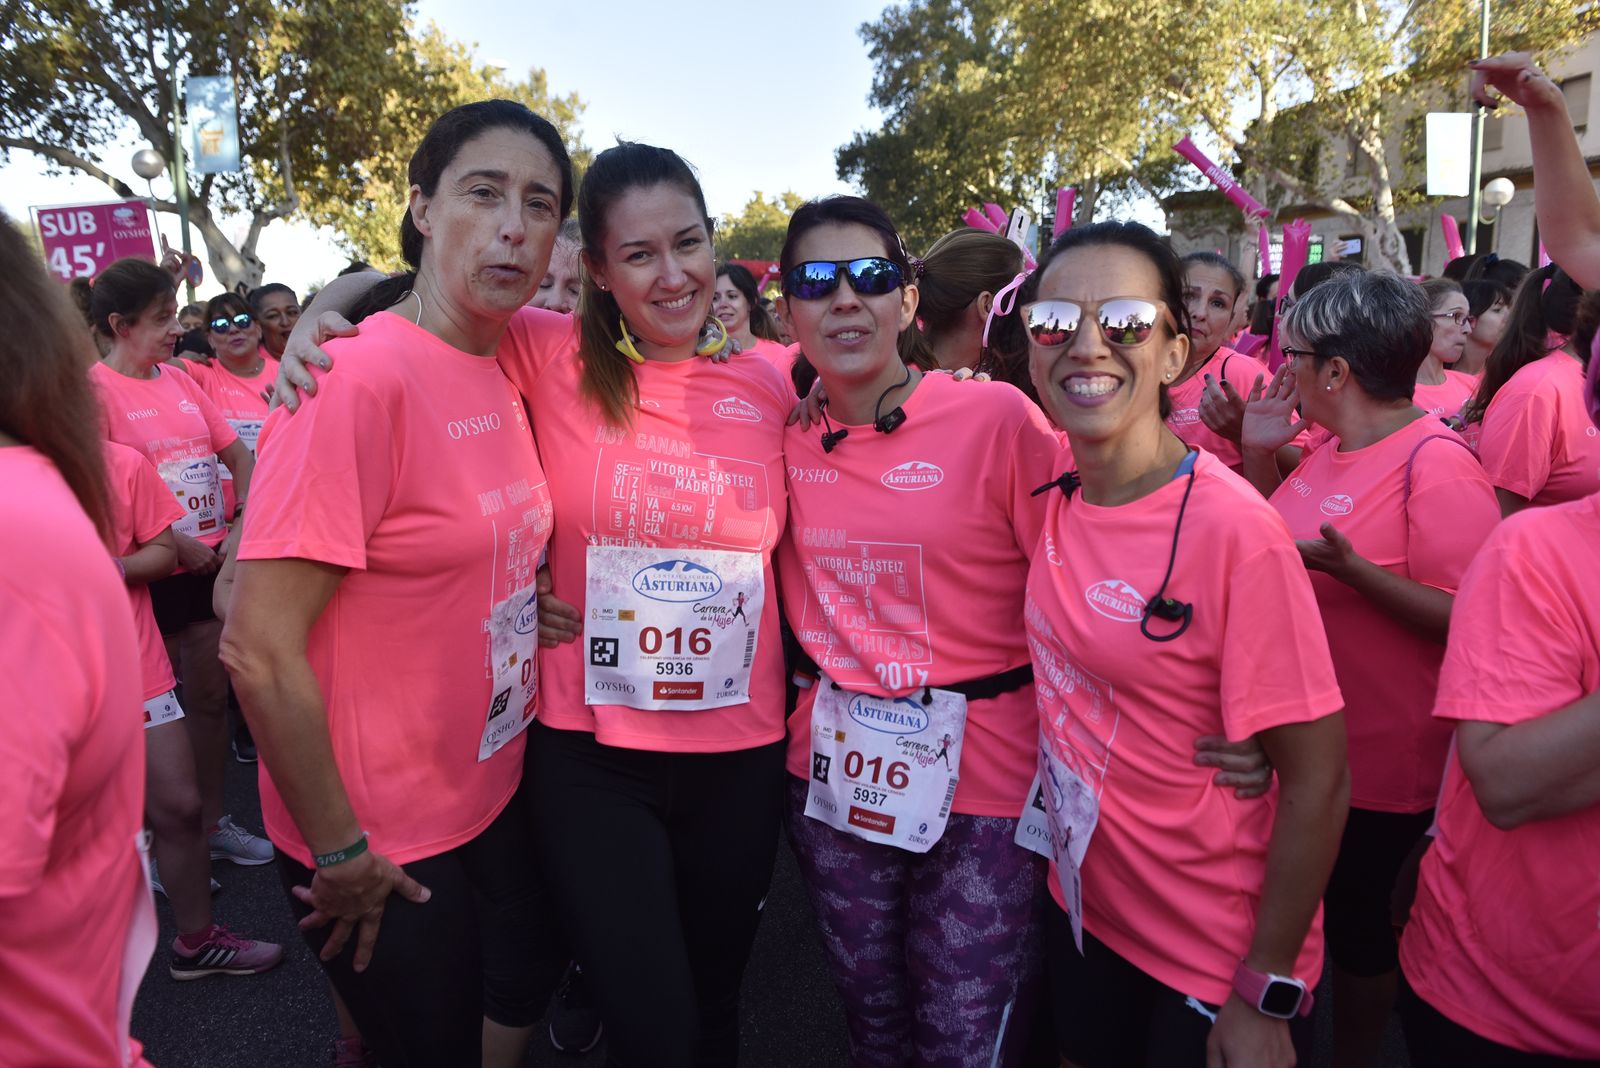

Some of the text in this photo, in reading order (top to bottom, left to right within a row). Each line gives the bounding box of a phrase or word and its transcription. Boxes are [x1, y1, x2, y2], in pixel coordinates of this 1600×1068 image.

[41, 210, 97, 237] SUB
[127, 408, 159, 421] OYSHO
[447, 412, 501, 440] OYSHO
[635, 433, 691, 458] GANAN
[650, 460, 696, 479] VITORIA
[709, 471, 754, 488] GASTEIZ
[885, 473, 938, 483] ASTURIANA
[675, 478, 724, 496] MADRID
[188, 493, 216, 510] 016
[645, 510, 665, 523] LEN
[671, 523, 699, 540] LAS
[803, 527, 847, 549] GANAN
[815, 556, 852, 571] VITORIA
[862, 560, 904, 573] GASTEIZ
[639, 574, 716, 593] ASTURIANA
[836, 571, 876, 585] MADRID
[692, 602, 726, 613] Carrera
[1088, 586, 1141, 618] ASTURIANA
[711, 613, 735, 630] Mujer
[842, 614, 867, 631] LAS
[638, 626, 712, 656] 016
[849, 632, 925, 660] CHICAS
[656, 662, 693, 675] 5936
[595, 680, 636, 695] OYSHO
[667, 686, 698, 695] Santander
[716, 689, 739, 699] ZURICH
[852, 699, 922, 729] ASTURIANA
[486, 720, 515, 744] OYSHO
[895, 736, 930, 753] Carrera
[913, 751, 939, 769] Mujer
[844, 750, 911, 790] 016
[853, 786, 888, 807] 5937
[813, 796, 838, 815] OYSHO
[860, 815, 889, 828] Santander
[908, 834, 930, 846] ZURICH
